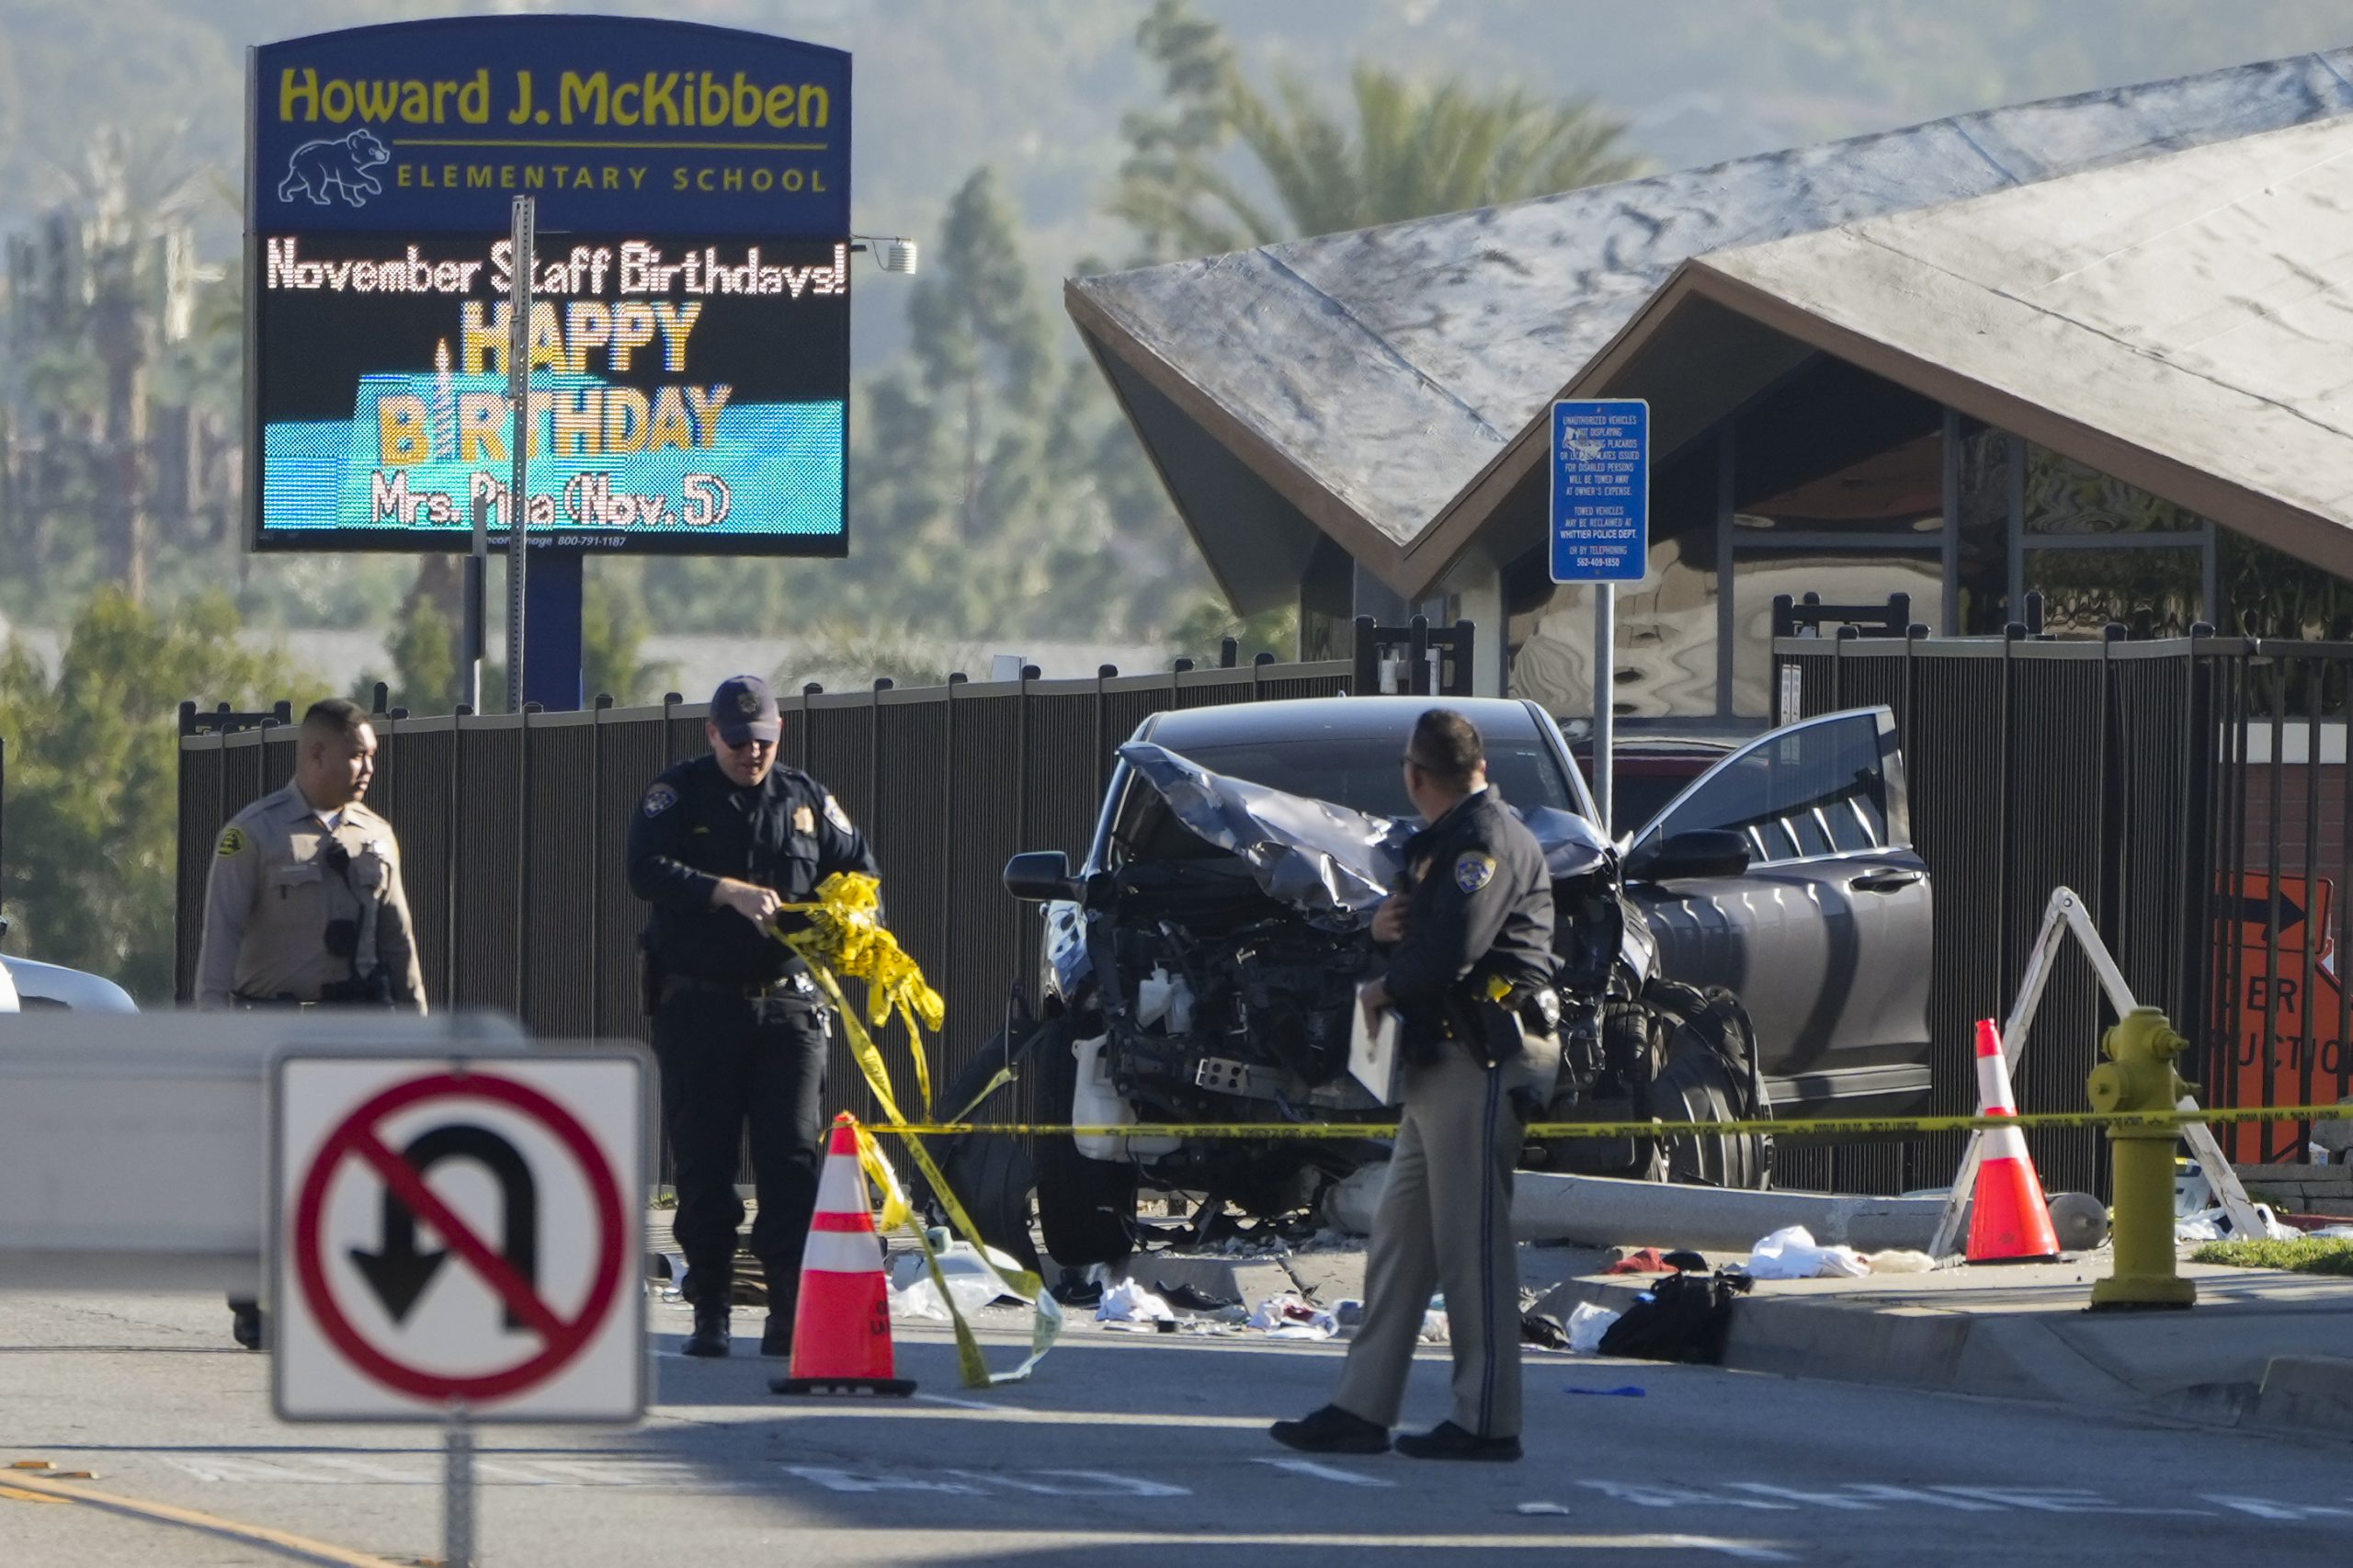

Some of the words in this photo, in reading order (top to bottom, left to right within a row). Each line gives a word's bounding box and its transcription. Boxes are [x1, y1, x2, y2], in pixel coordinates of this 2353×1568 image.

[279, 67, 490, 124] Howard
[507, 70, 551, 125] J.
[559, 71, 830, 128] McKibben
[397, 165, 648, 190] ELEMENTARY
[673, 168, 827, 193] SCHOOL
[267, 237, 481, 293] November
[620, 241, 848, 300] Birthdays!
[461, 301, 702, 375] HAPPY
[370, 471, 461, 525] Mrs.
[563, 472, 676, 527] (Nov.
[683, 472, 732, 526] 5)
[557, 535, 628, 547] 800-791-1187
[1560, 529, 1591, 539] WHITTIER
[1593, 529, 1618, 539] POLICE
[1619, 529, 1637, 539] DEPT.
